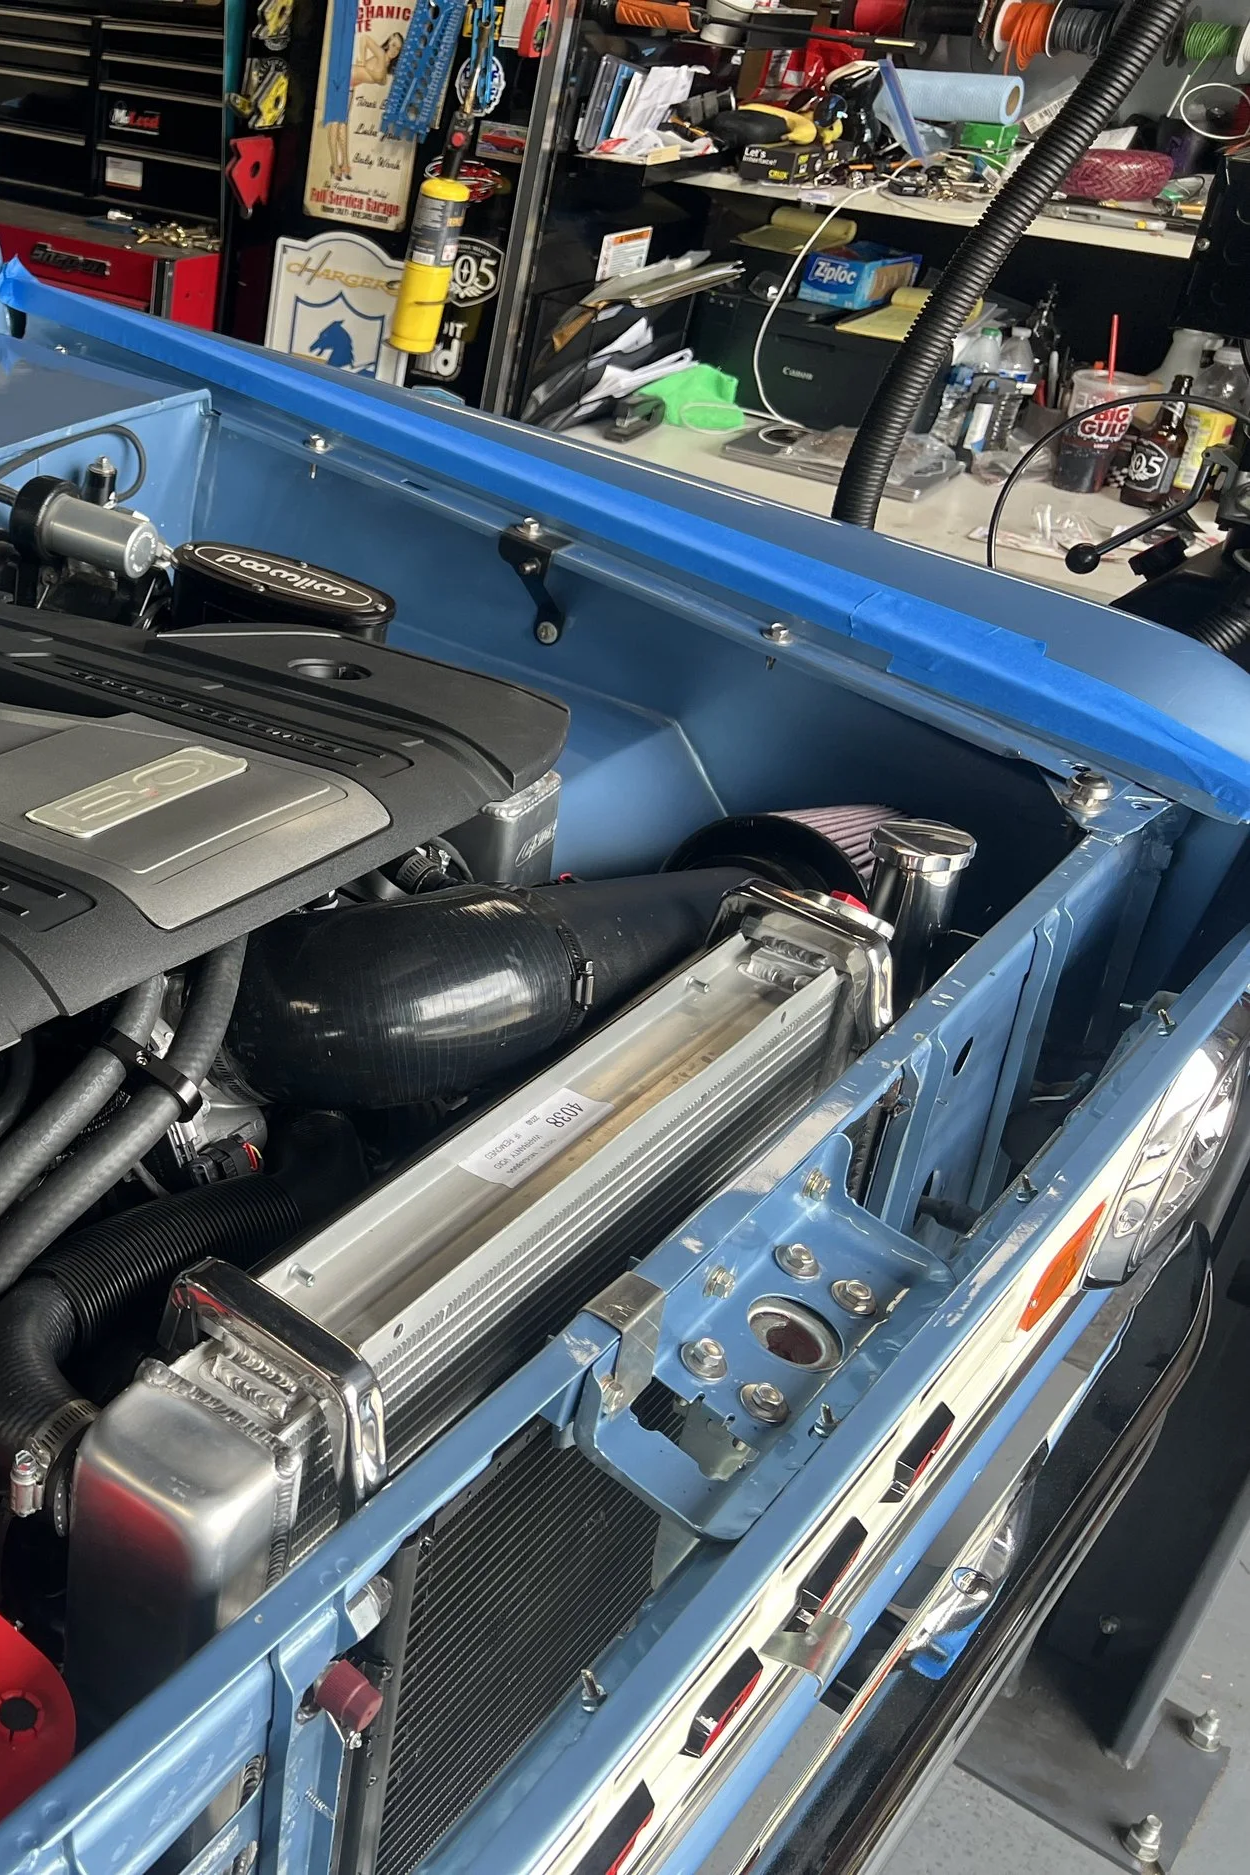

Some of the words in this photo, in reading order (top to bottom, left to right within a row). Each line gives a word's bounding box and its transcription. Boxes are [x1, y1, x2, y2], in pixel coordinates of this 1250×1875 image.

[744, 147, 766, 159] Let's
[310, 188, 327, 203] Full
[328, 191, 364, 210] Service
[365, 198, 400, 217] Garage
[814, 261, 857, 285] Ziploc
[782, 366, 814, 381] Canon
[1094, 407, 1130, 423] BIG
[1081, 420, 1129, 438] GULP
[215, 554, 346, 596] wilwood
[546, 1102, 584, 1128] 4038
